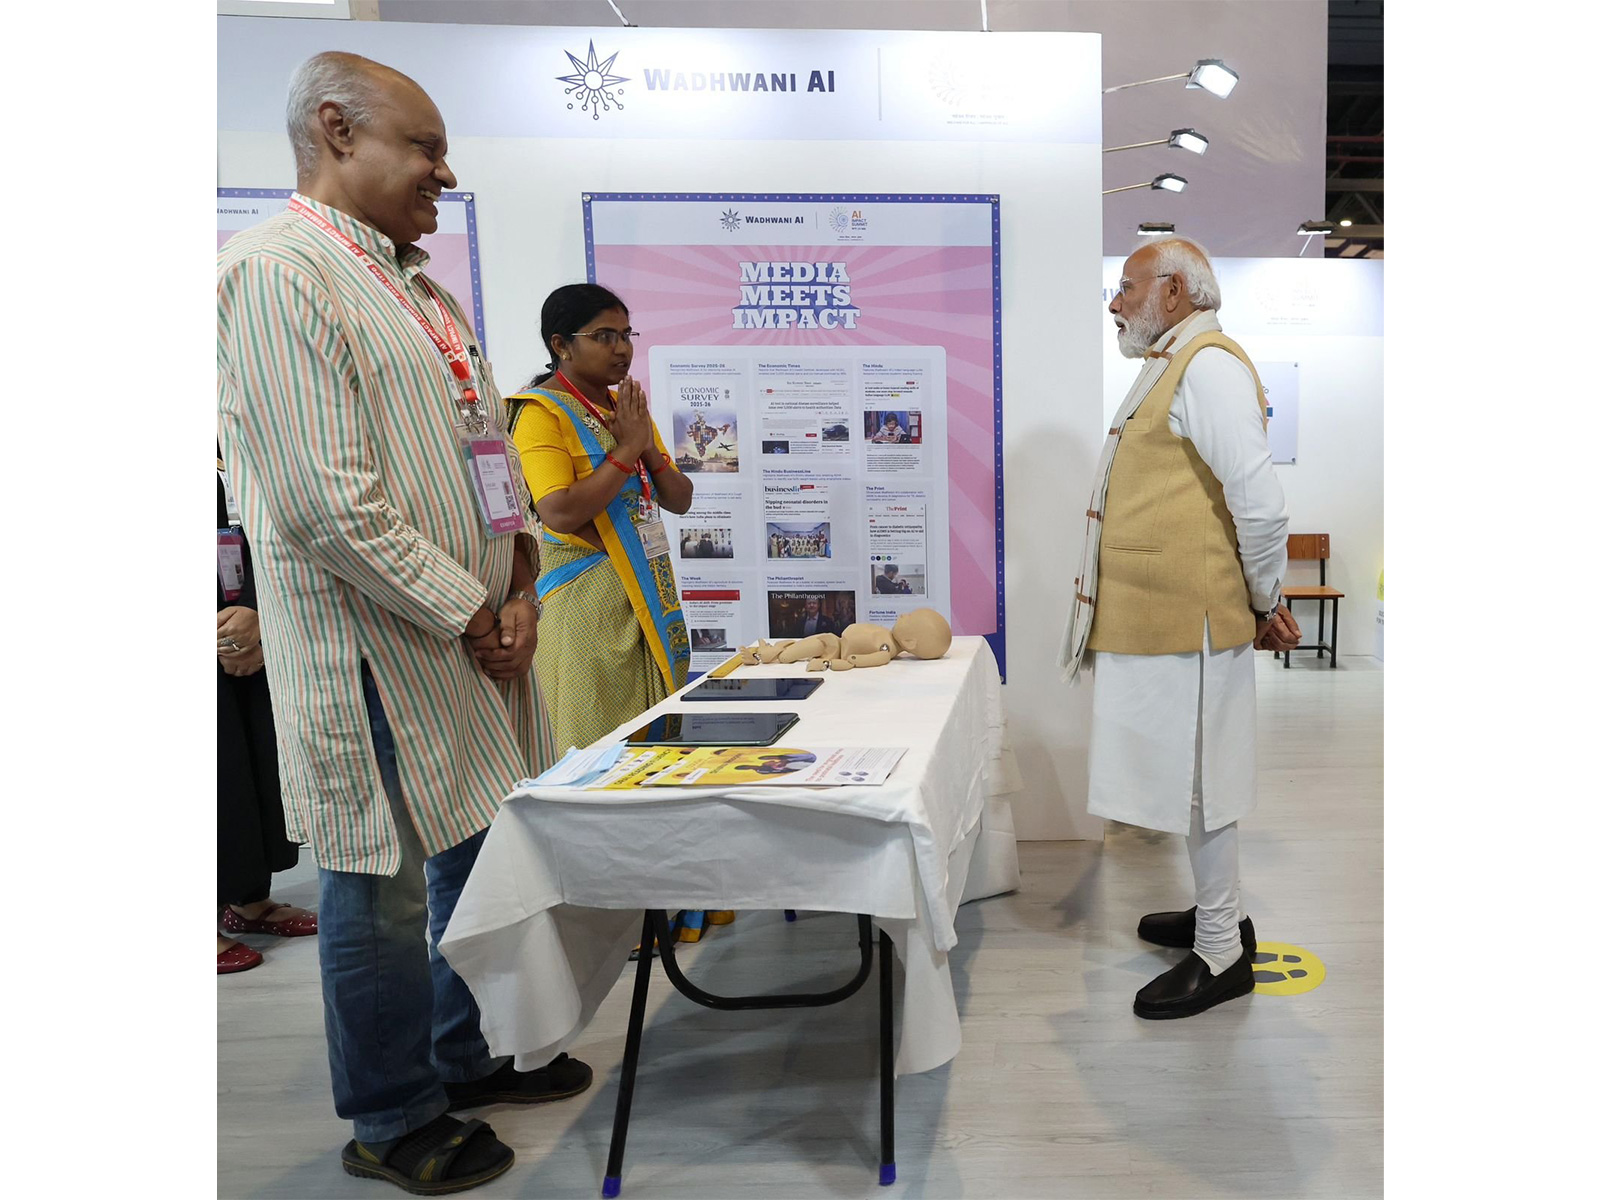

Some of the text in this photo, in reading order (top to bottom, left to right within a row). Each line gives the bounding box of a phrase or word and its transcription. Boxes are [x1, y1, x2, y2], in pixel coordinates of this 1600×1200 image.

[643, 68, 835, 93] WADHWANI AI
[299, 207, 327, 228] SUMMIT
[745, 215, 804, 225] WADHWANI AI
[851, 210, 862, 219] AI
[326, 226, 352, 248] IMPACT
[351, 246, 360, 255] AI
[738, 261, 851, 283] MEDIA
[739, 284, 852, 307] MEETS
[399, 297, 422, 321] SUMMIT
[731, 307, 862, 330] IMPACT
[420, 321, 442, 344] IMPACT
[448, 325, 459, 343] IMPACT
[439, 342, 448, 351] AI
[680, 386, 720, 394] ECONOMIC
[784, 592, 826, 601] Philanthropist
